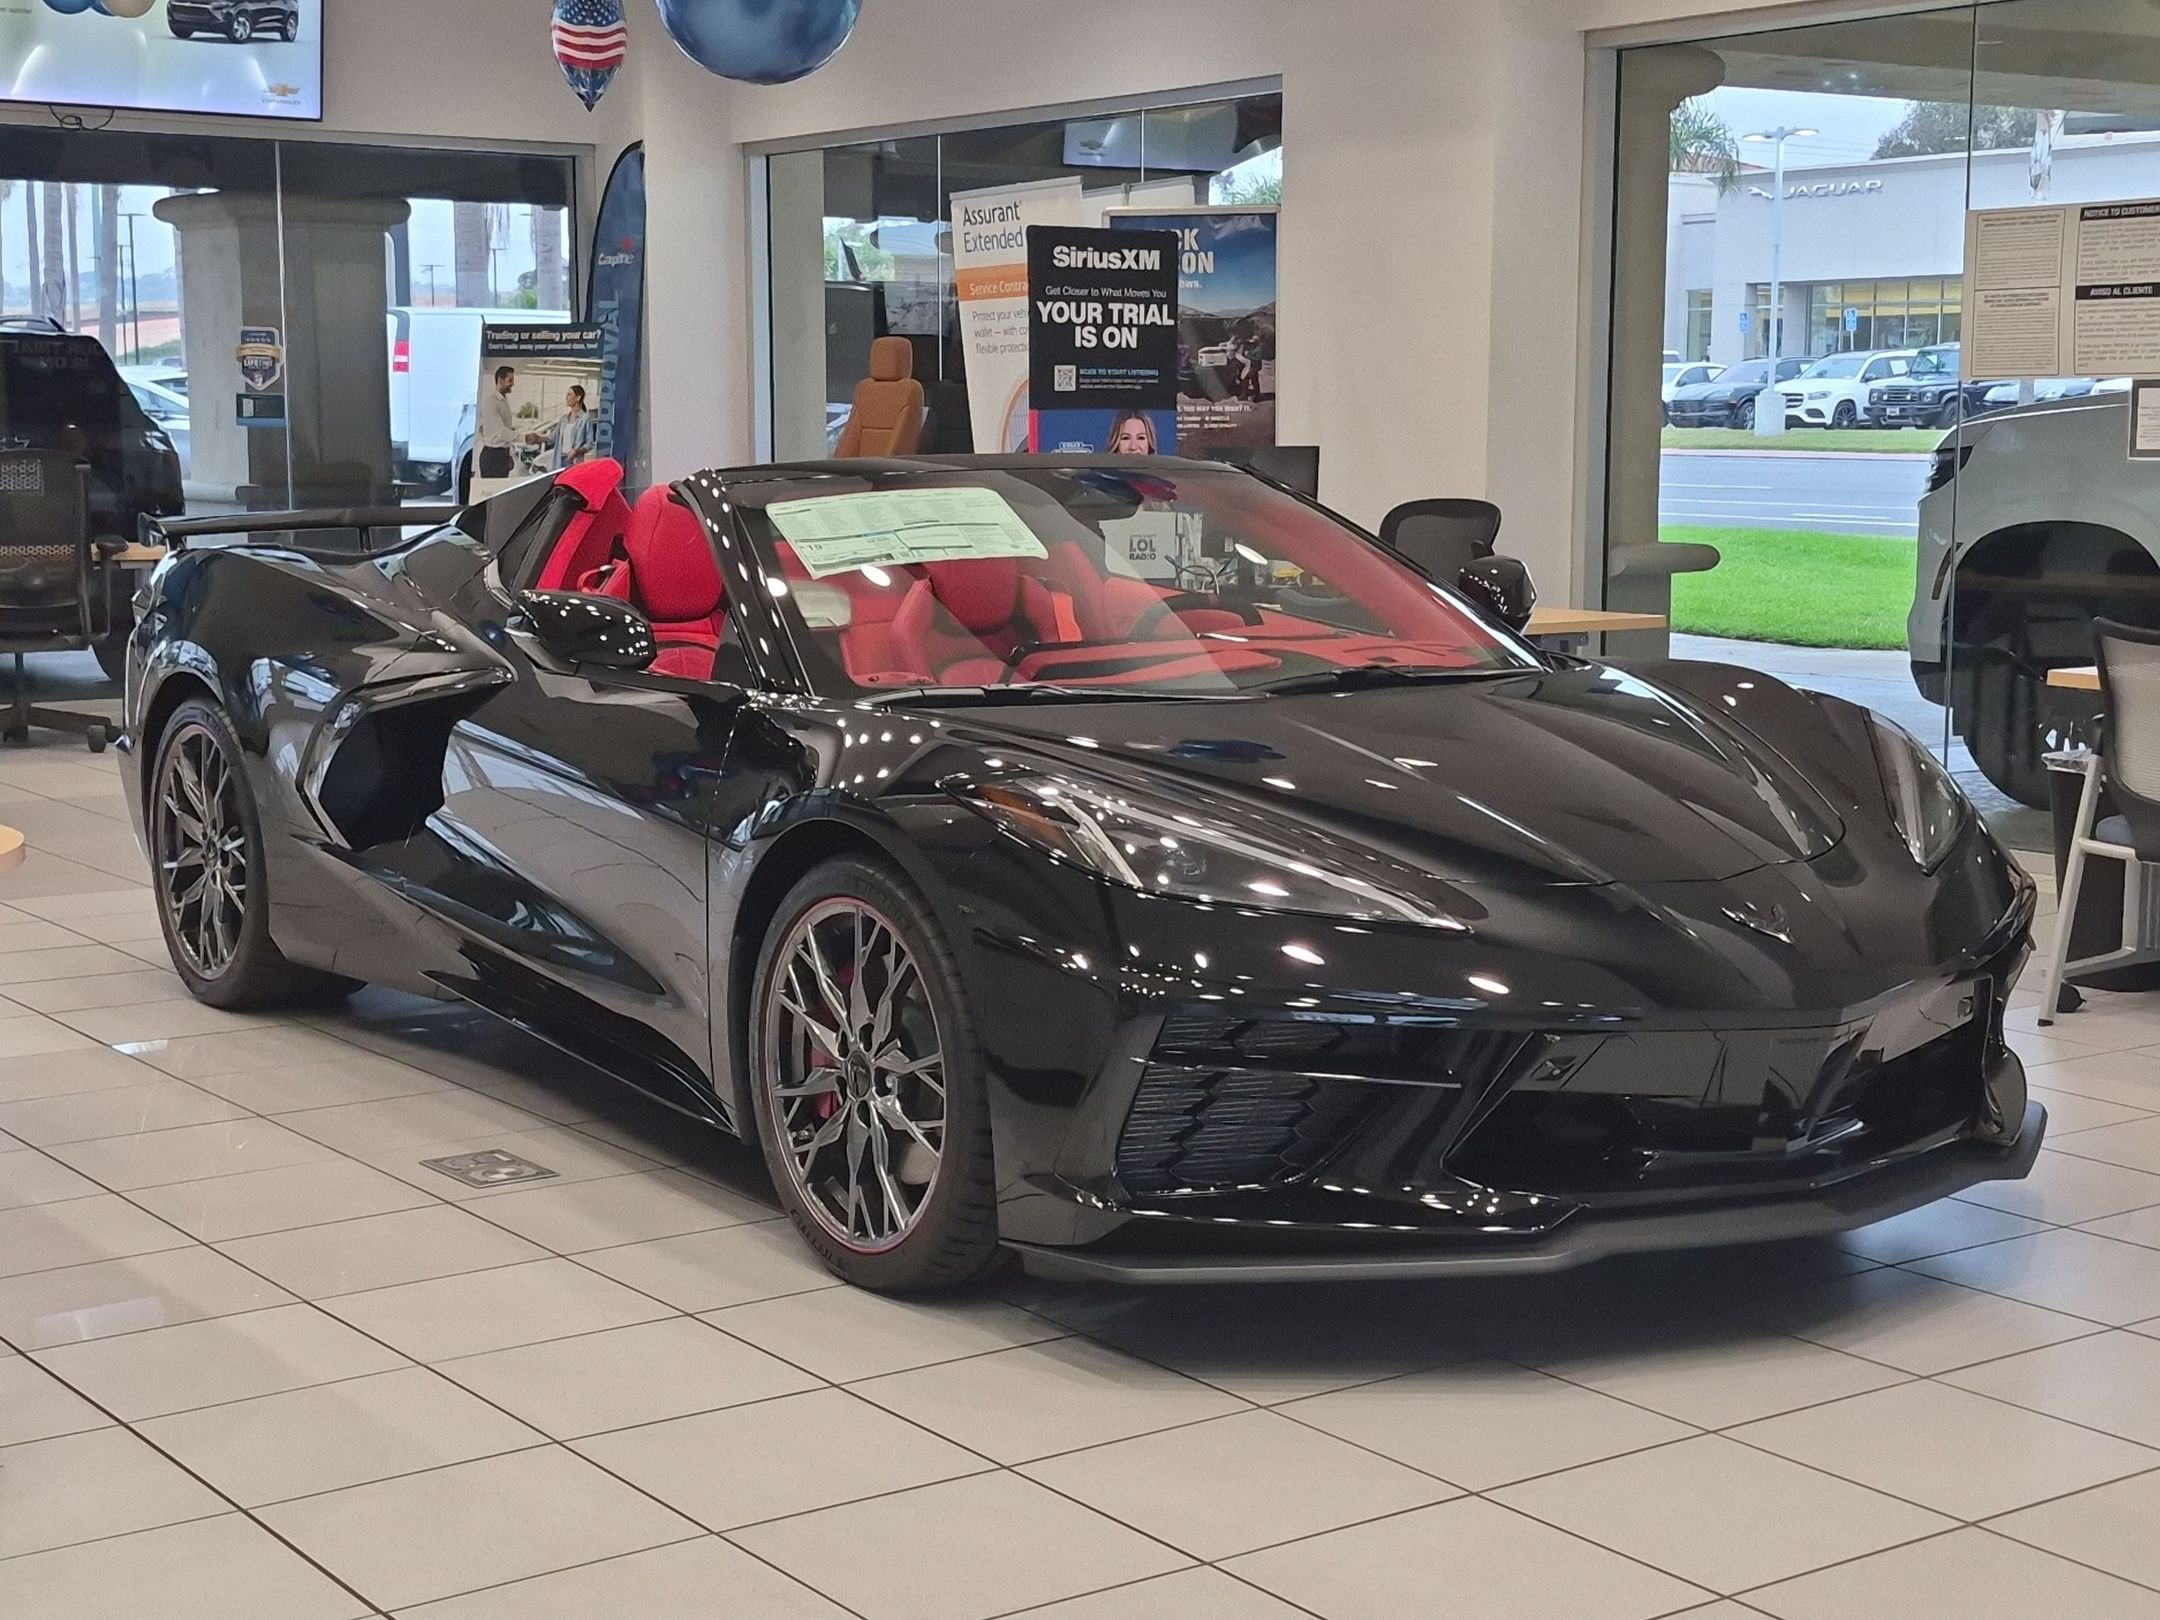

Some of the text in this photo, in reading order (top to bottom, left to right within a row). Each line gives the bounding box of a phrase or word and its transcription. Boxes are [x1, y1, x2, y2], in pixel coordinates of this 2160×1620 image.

[1783, 180, 1883, 200] JAGUAR
[963, 202, 1021, 227] Assurant
[2083, 208, 2110, 218] NOTICE
[2111, 208, 2121, 217] TO
[964, 226, 1023, 253] Extended
[1053, 245, 1160, 271] SiriusXM
[969, 282, 999, 296] Service
[1045, 286, 1167, 298] Get Closer to What Moves You
[2112, 287, 2122, 296] AL
[1036, 301, 1175, 326] YOUR TRIAL
[486, 331, 519, 341] Trading
[531, 331, 560, 341] selling
[562, 331, 581, 341] your
[582, 330, 601, 340] car?
[1075, 325, 1138, 348] IS ON
[1129, 538, 1156, 552] LOL
[1129, 552, 1157, 561] RADIO
